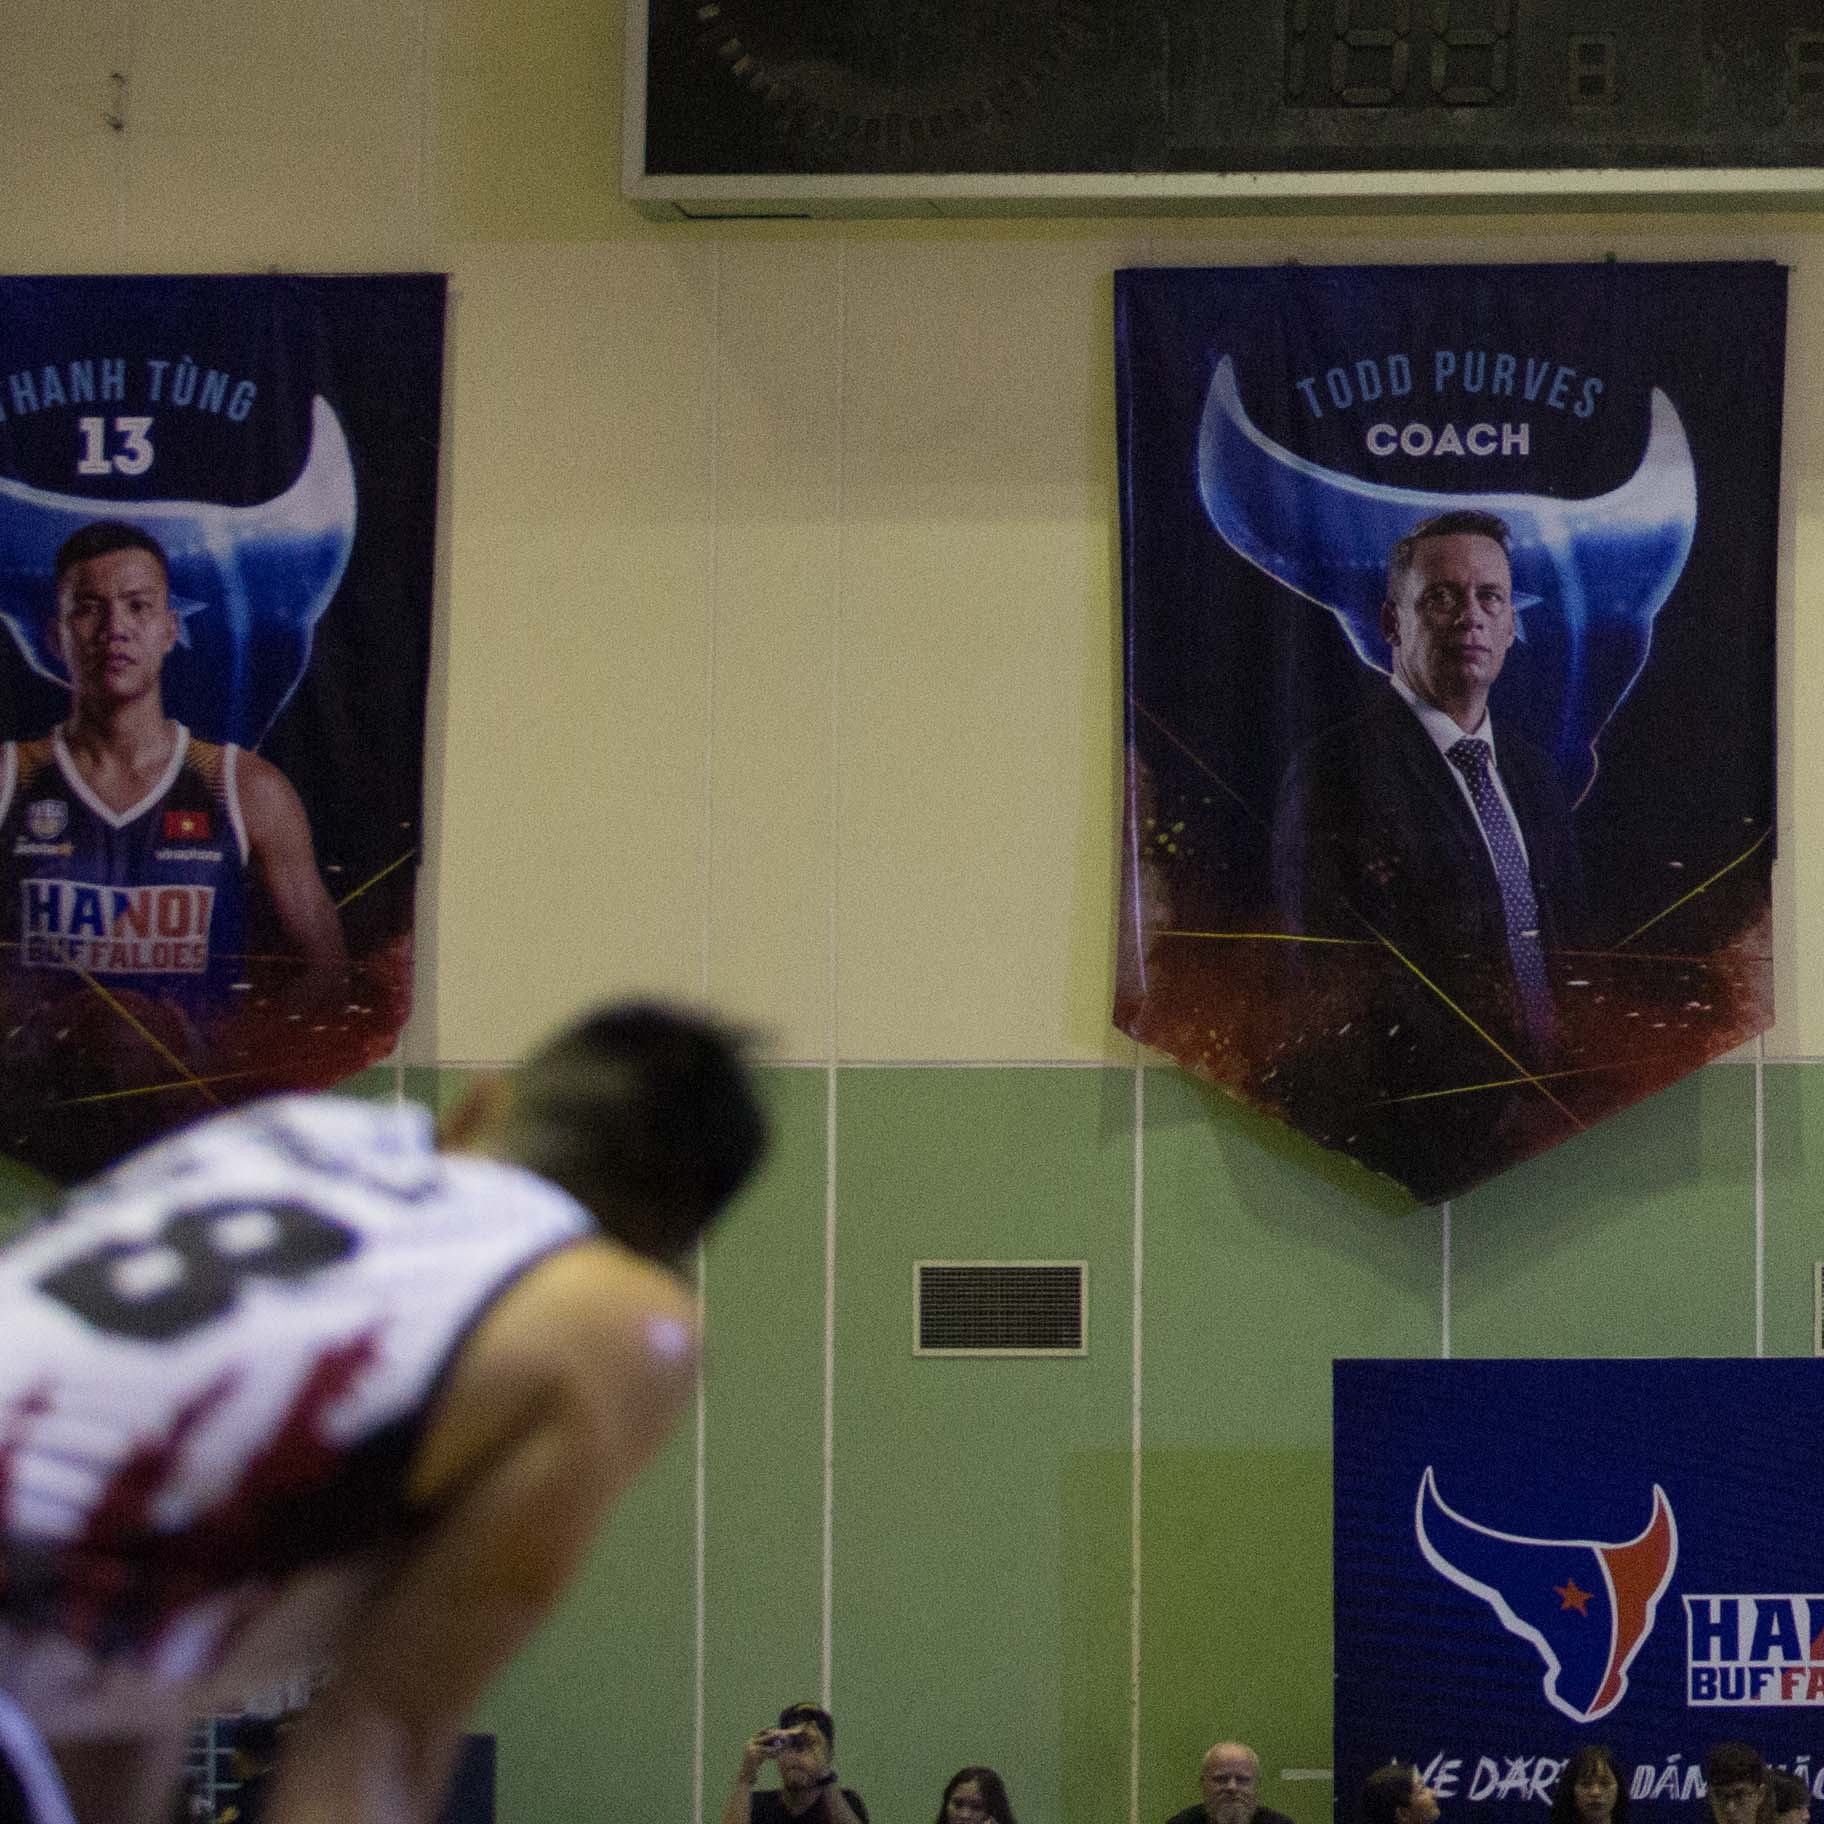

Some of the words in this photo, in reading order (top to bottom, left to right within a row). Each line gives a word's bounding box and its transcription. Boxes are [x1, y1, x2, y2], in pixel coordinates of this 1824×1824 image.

[0, 358, 126, 422] HANH
[147, 354, 257, 422] TÙNG
[1296, 354, 1412, 418] TODD
[1434, 350, 1603, 418] PURVES
[77, 416, 155, 476] 13
[1366, 423, 1530, 456] COACH
[27, 882, 211, 939] HANOI
[1468, 1754, 1570, 1806] DAR
